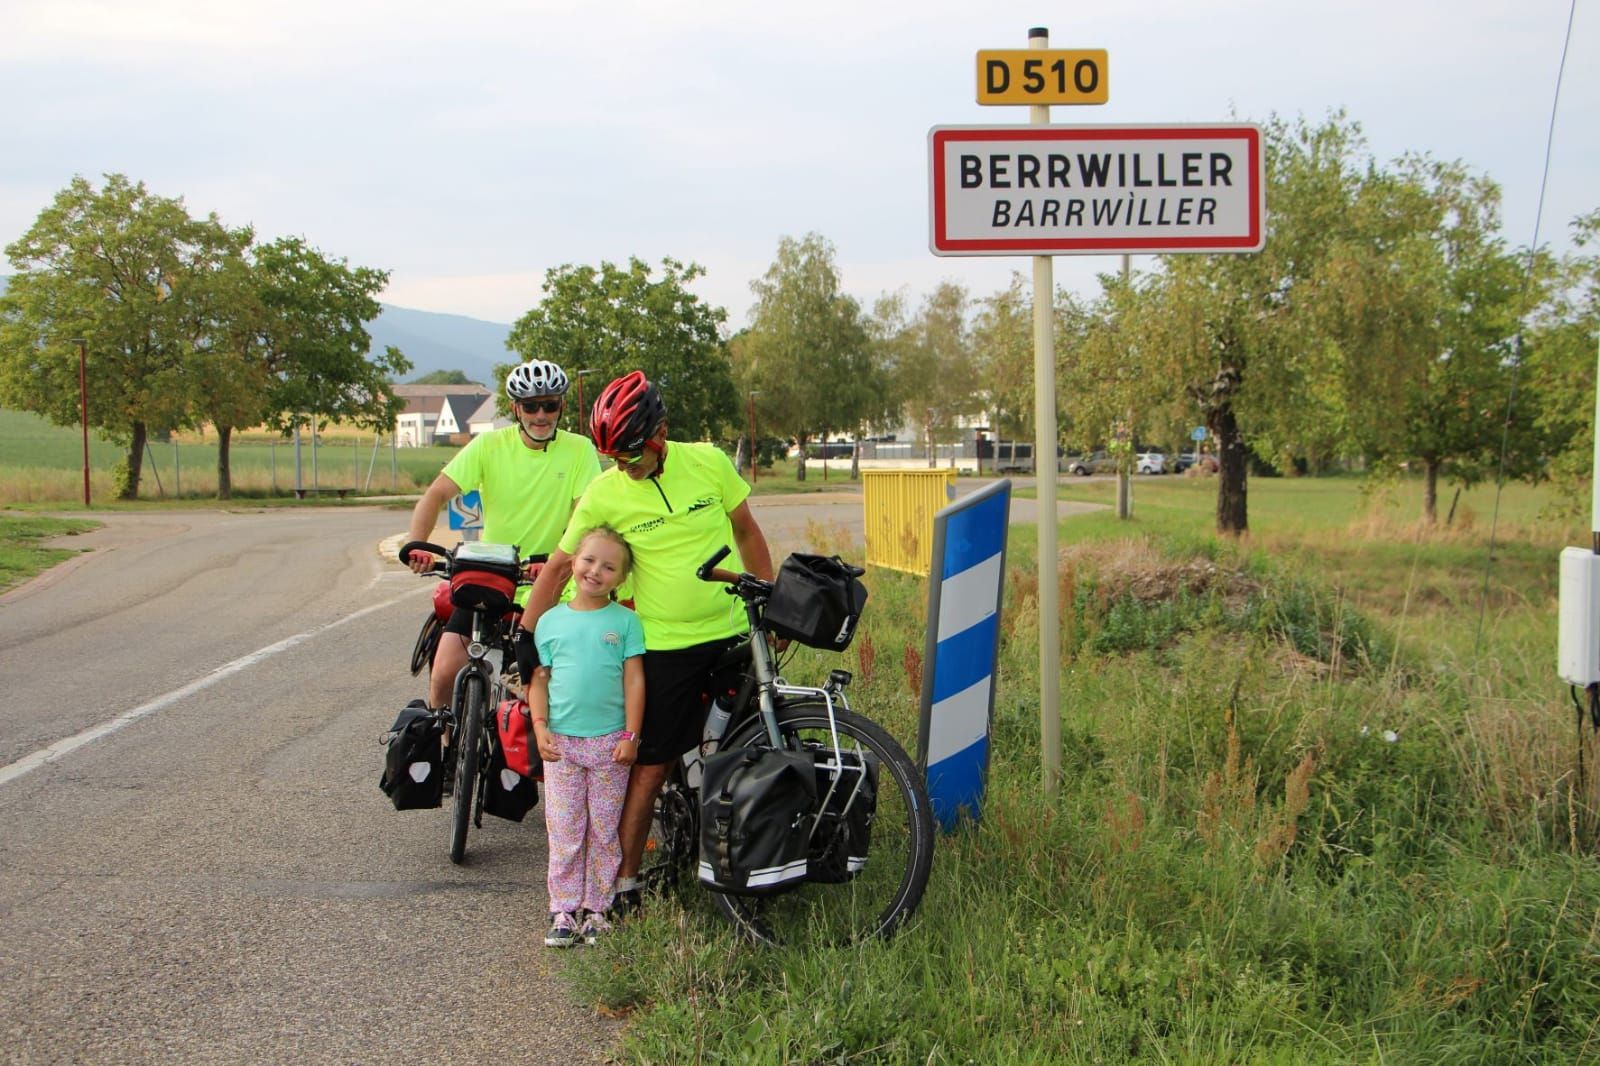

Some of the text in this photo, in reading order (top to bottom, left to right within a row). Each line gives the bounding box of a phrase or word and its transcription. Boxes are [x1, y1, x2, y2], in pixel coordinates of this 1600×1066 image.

[986, 59, 1099, 94] D 510
[960, 153, 1233, 188] BERRWILLER
[992, 192, 1217, 227] BARRWÌLLER
